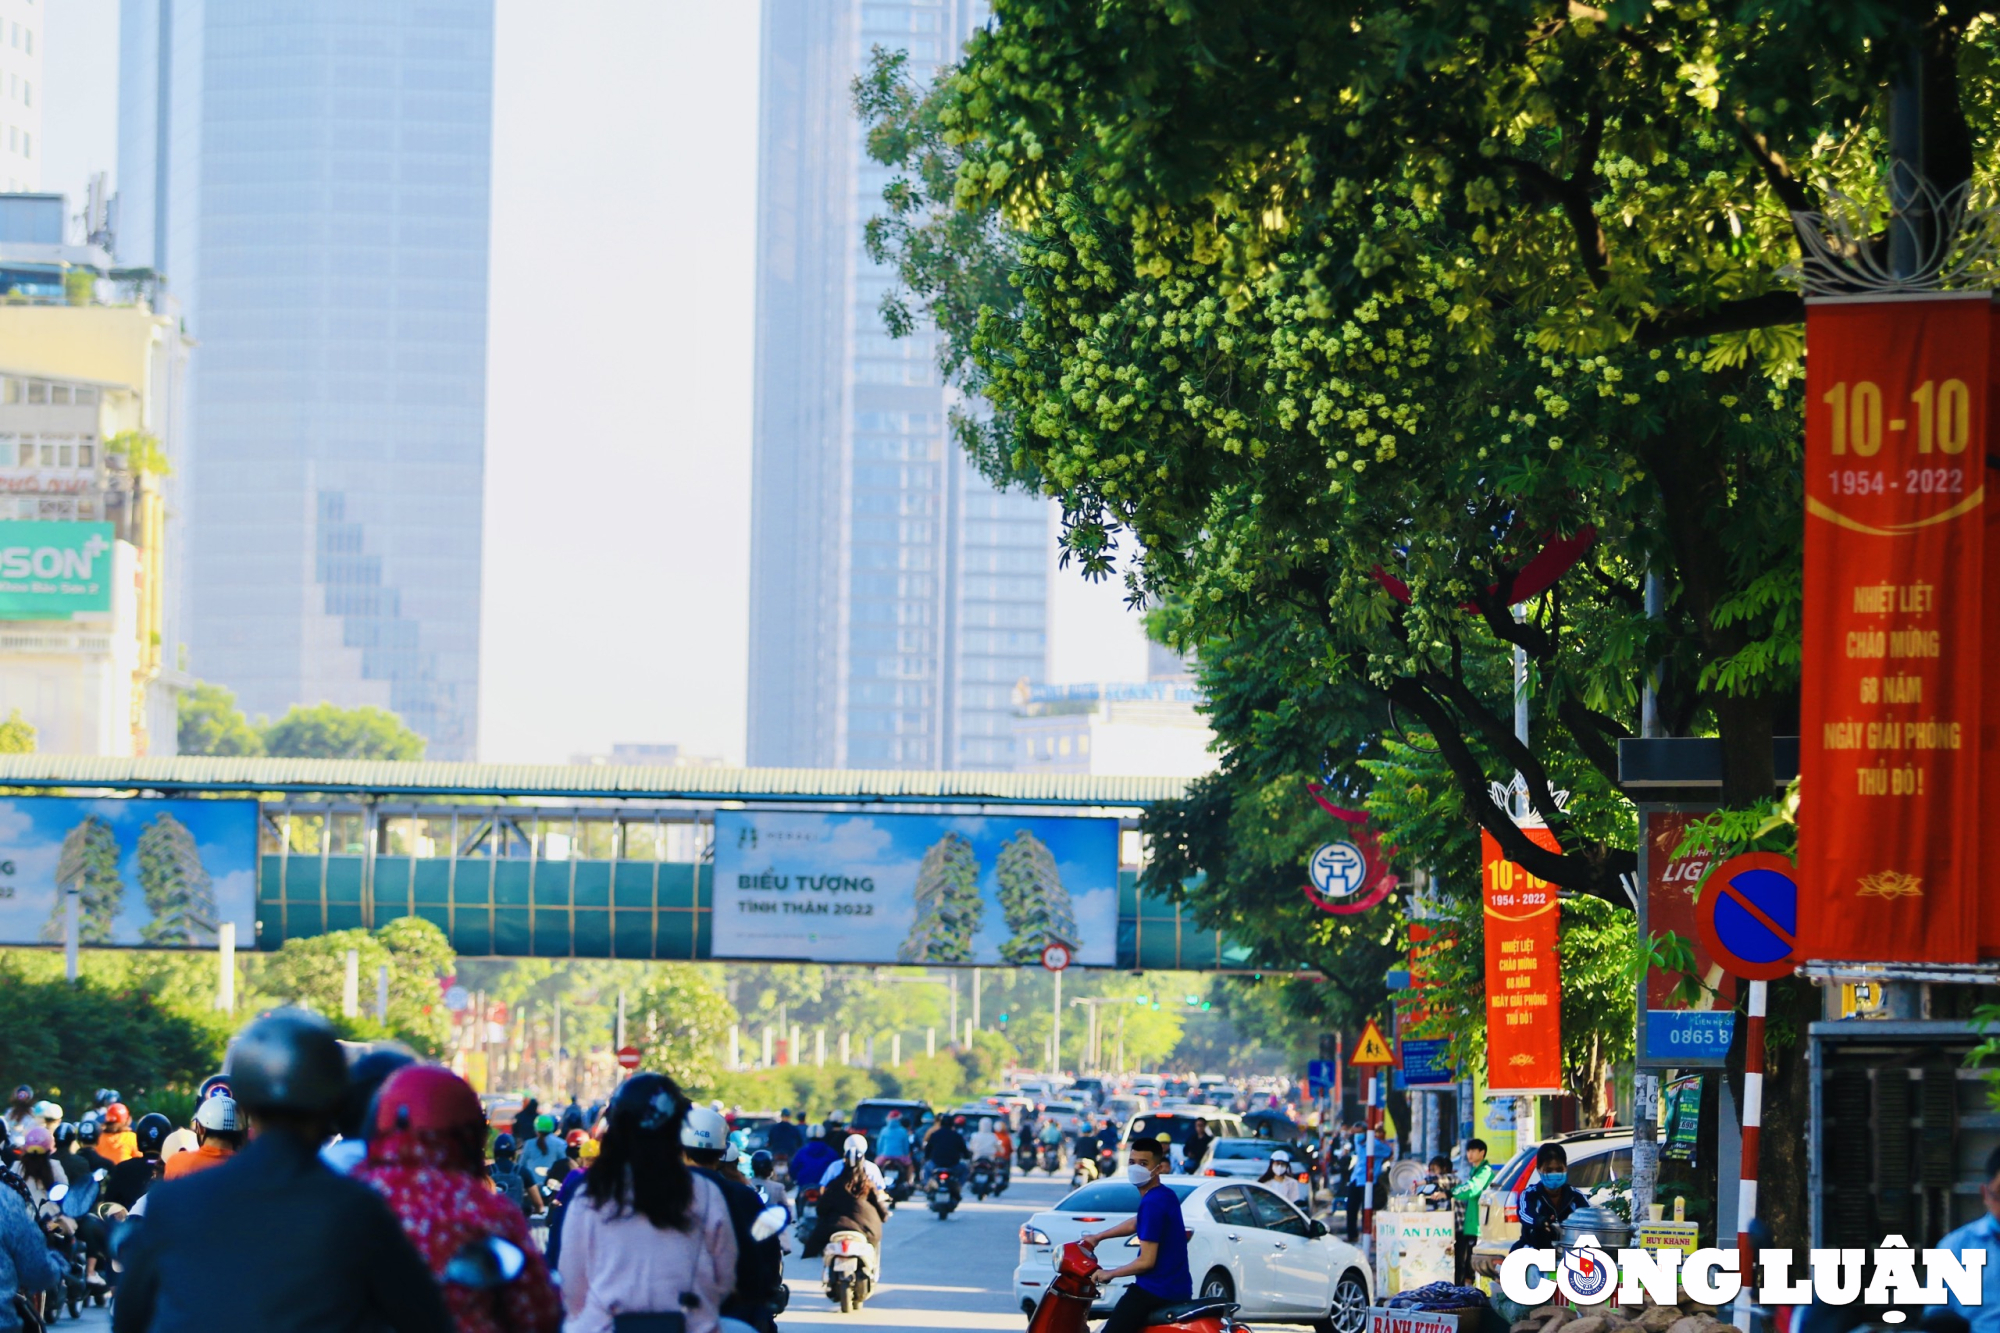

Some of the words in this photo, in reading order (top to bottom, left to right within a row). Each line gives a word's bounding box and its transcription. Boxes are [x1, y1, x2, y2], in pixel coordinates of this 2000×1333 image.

[1829, 470, 1884, 495] 1954
[1905, 468, 1963, 494] 2022
[1854, 580, 1896, 620] NHIỆT
[1900, 579, 1934, 619] LIỆT
[1846, 625, 1886, 658] CHÀO
[1890, 624, 1940, 658] MỪNG
[1860, 676, 1879, 703] 68
[1883, 671, 1922, 703] NĂM
[1824, 716, 1863, 749] NGÀY
[1867, 713, 1900, 749] GIẢI
[1904, 716, 1961, 749] PHÓNG
[1857, 758, 1888, 795] THỦ
[738, 866, 788, 890] BIỂU
[796, 875, 874, 896] TƯỢNG
[833, 904, 873, 915] 2022
[1491, 894, 1514, 906] 1954
[1522, 893, 1546, 905] 2022
[1670, 1029, 1714, 1044] 0865
[1720, 1029, 1734, 1044] 8
[694, 1130, 710, 1138] ACB
[1402, 1228, 1421, 1237] AN
[1646, 1236, 1662, 1245] HUY
